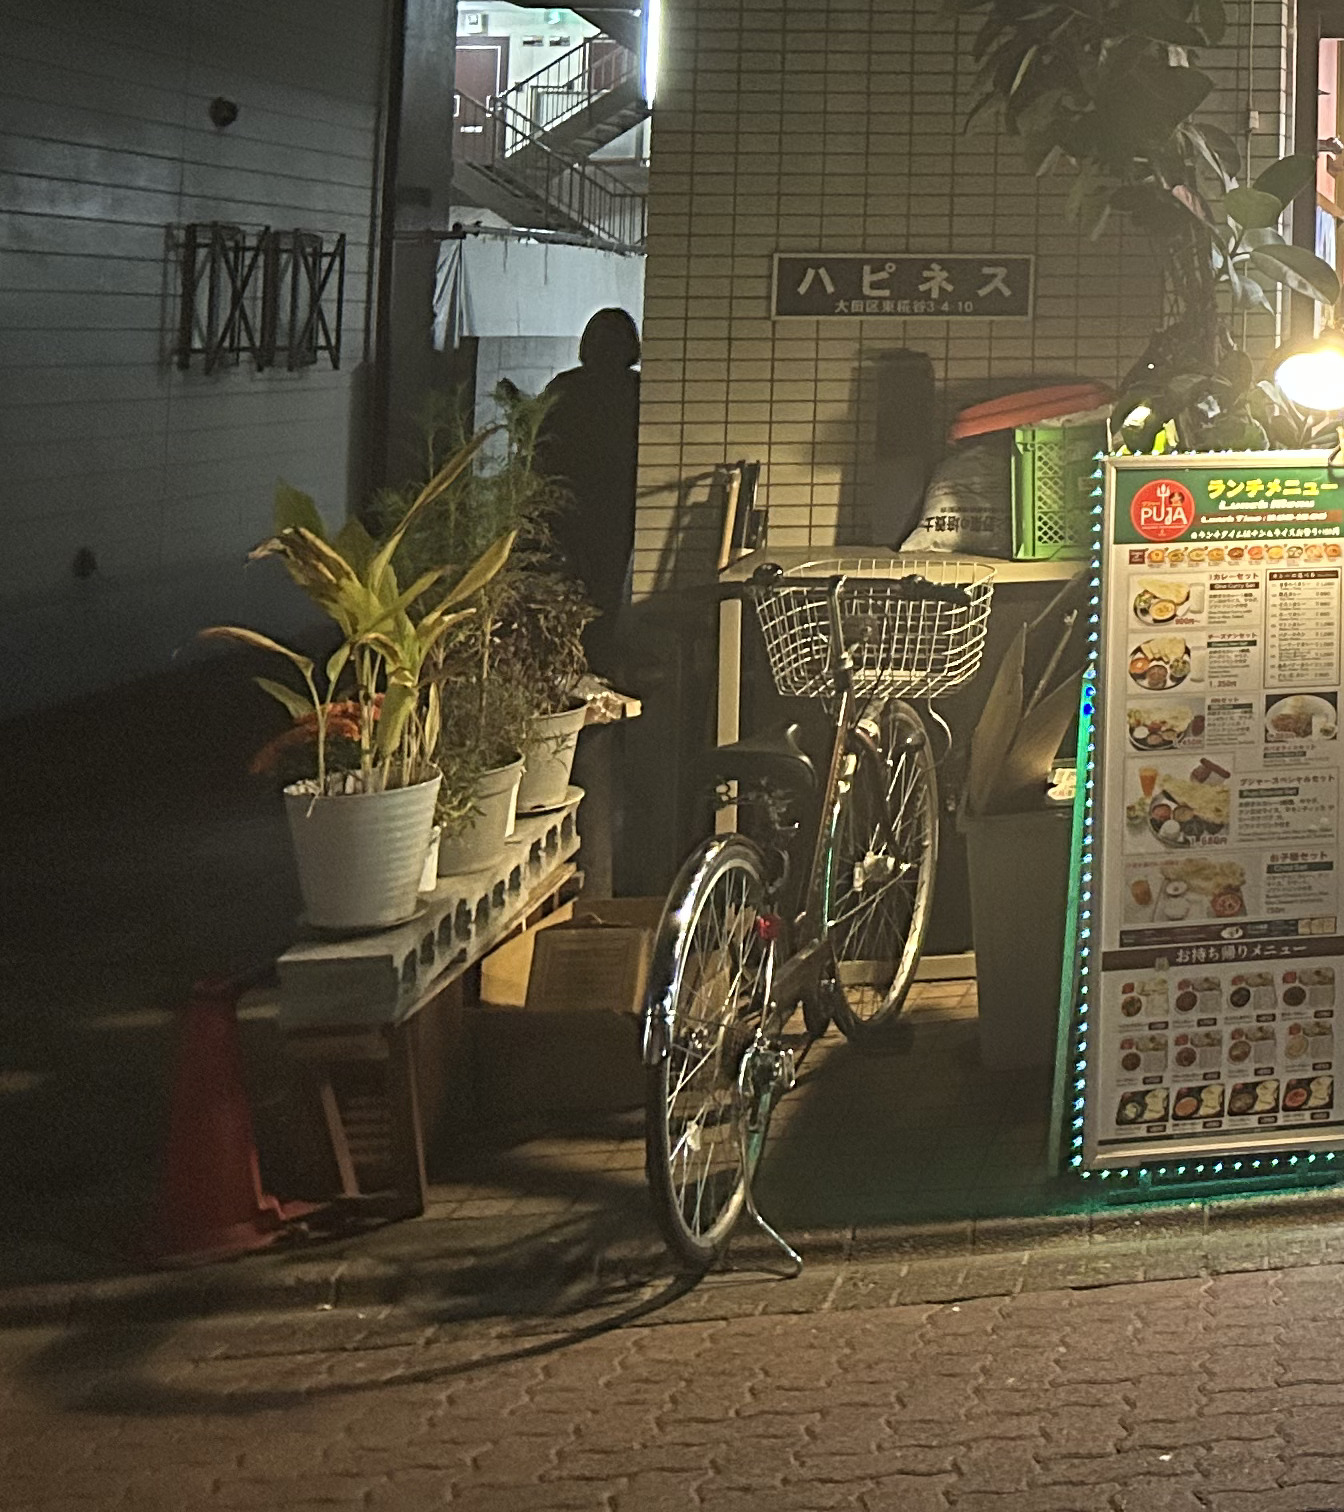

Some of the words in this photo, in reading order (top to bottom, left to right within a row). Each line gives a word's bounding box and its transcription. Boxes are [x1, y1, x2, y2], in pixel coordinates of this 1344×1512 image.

[797, 262, 1012, 298] ハピネス
[1207, 478, 1339, 499] ランチメニュー
[1140, 506, 1188, 526] PUJA
[1175, 944, 1308, 963] お持ち帰りメニュー
